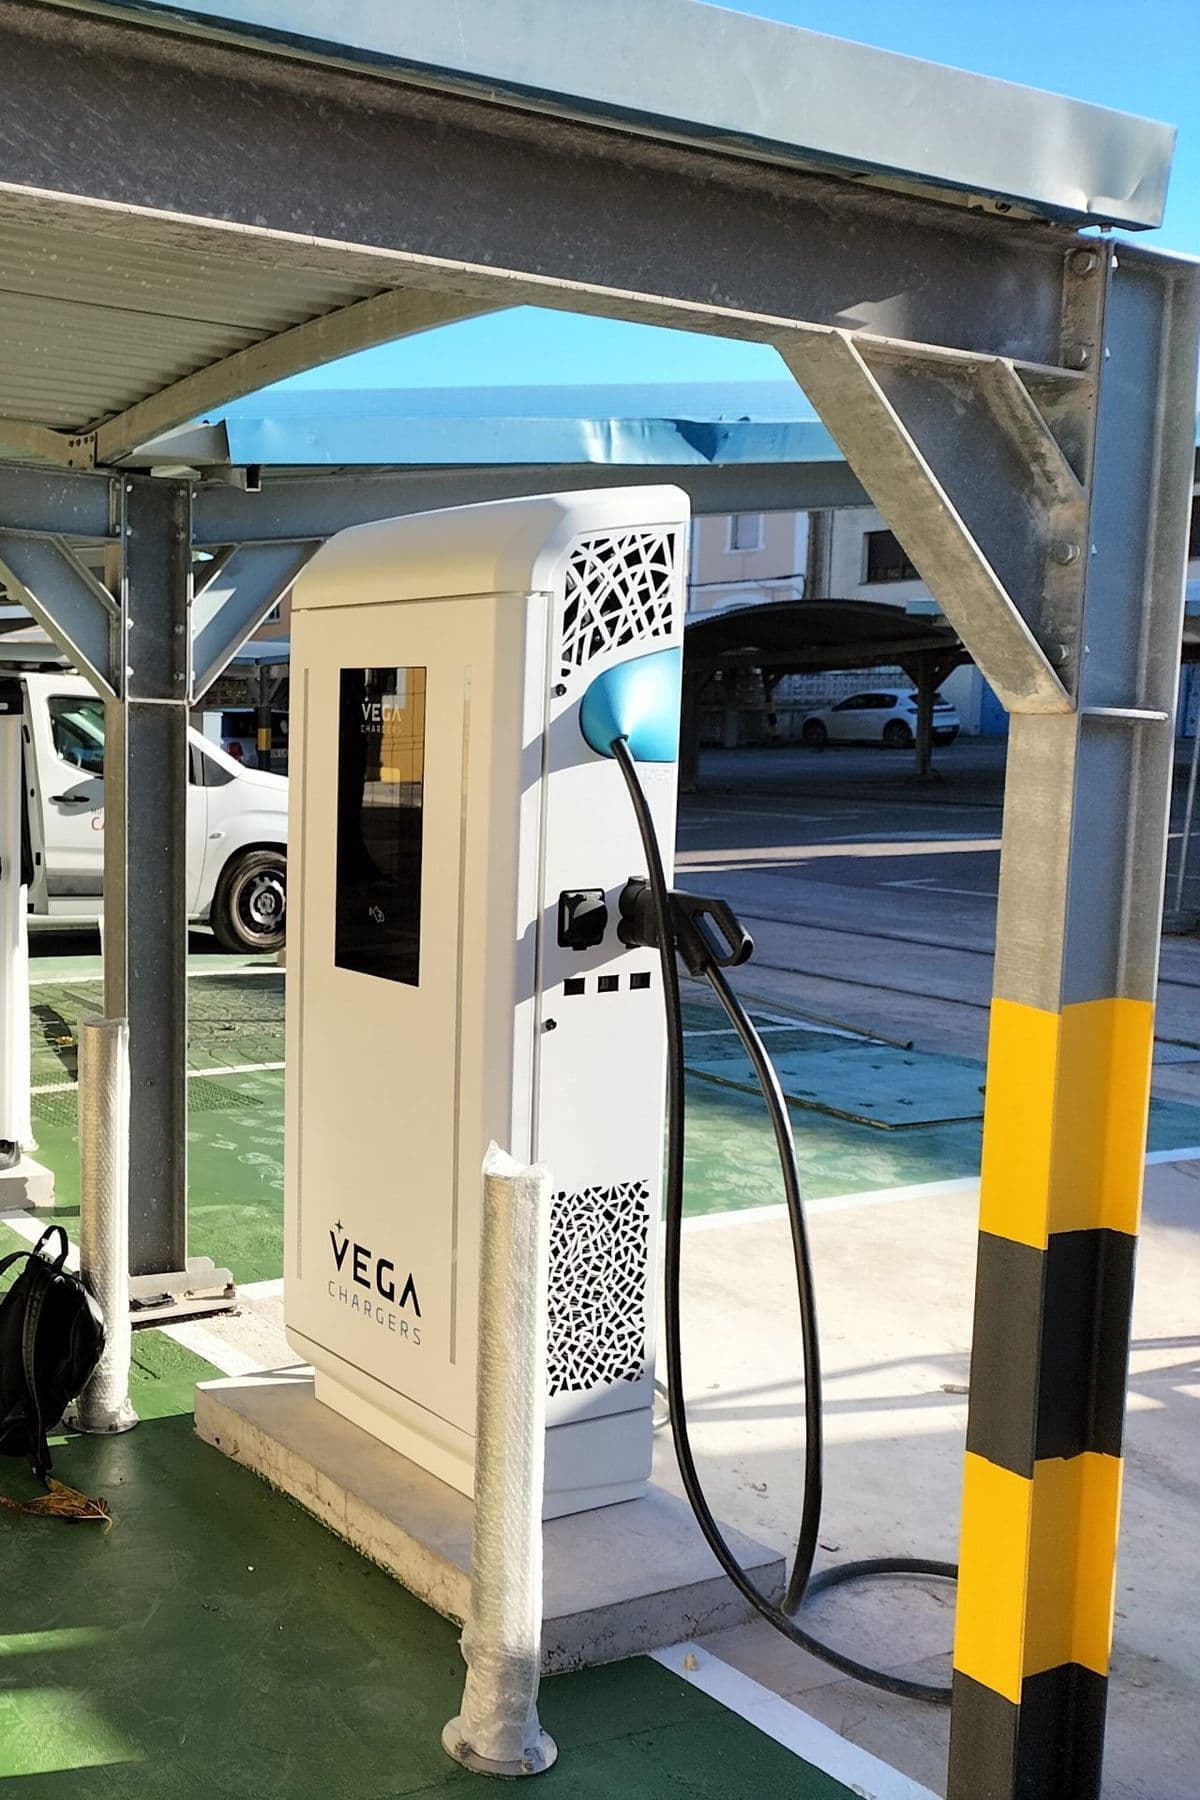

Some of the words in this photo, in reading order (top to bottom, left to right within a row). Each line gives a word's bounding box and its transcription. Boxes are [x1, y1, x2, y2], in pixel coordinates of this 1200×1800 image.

[361, 703, 402, 722] VEGA
[91, 816, 105, 831] C
[329, 1230, 422, 1318] VEGA
[328, 1280, 422, 1346] CHARGERS
